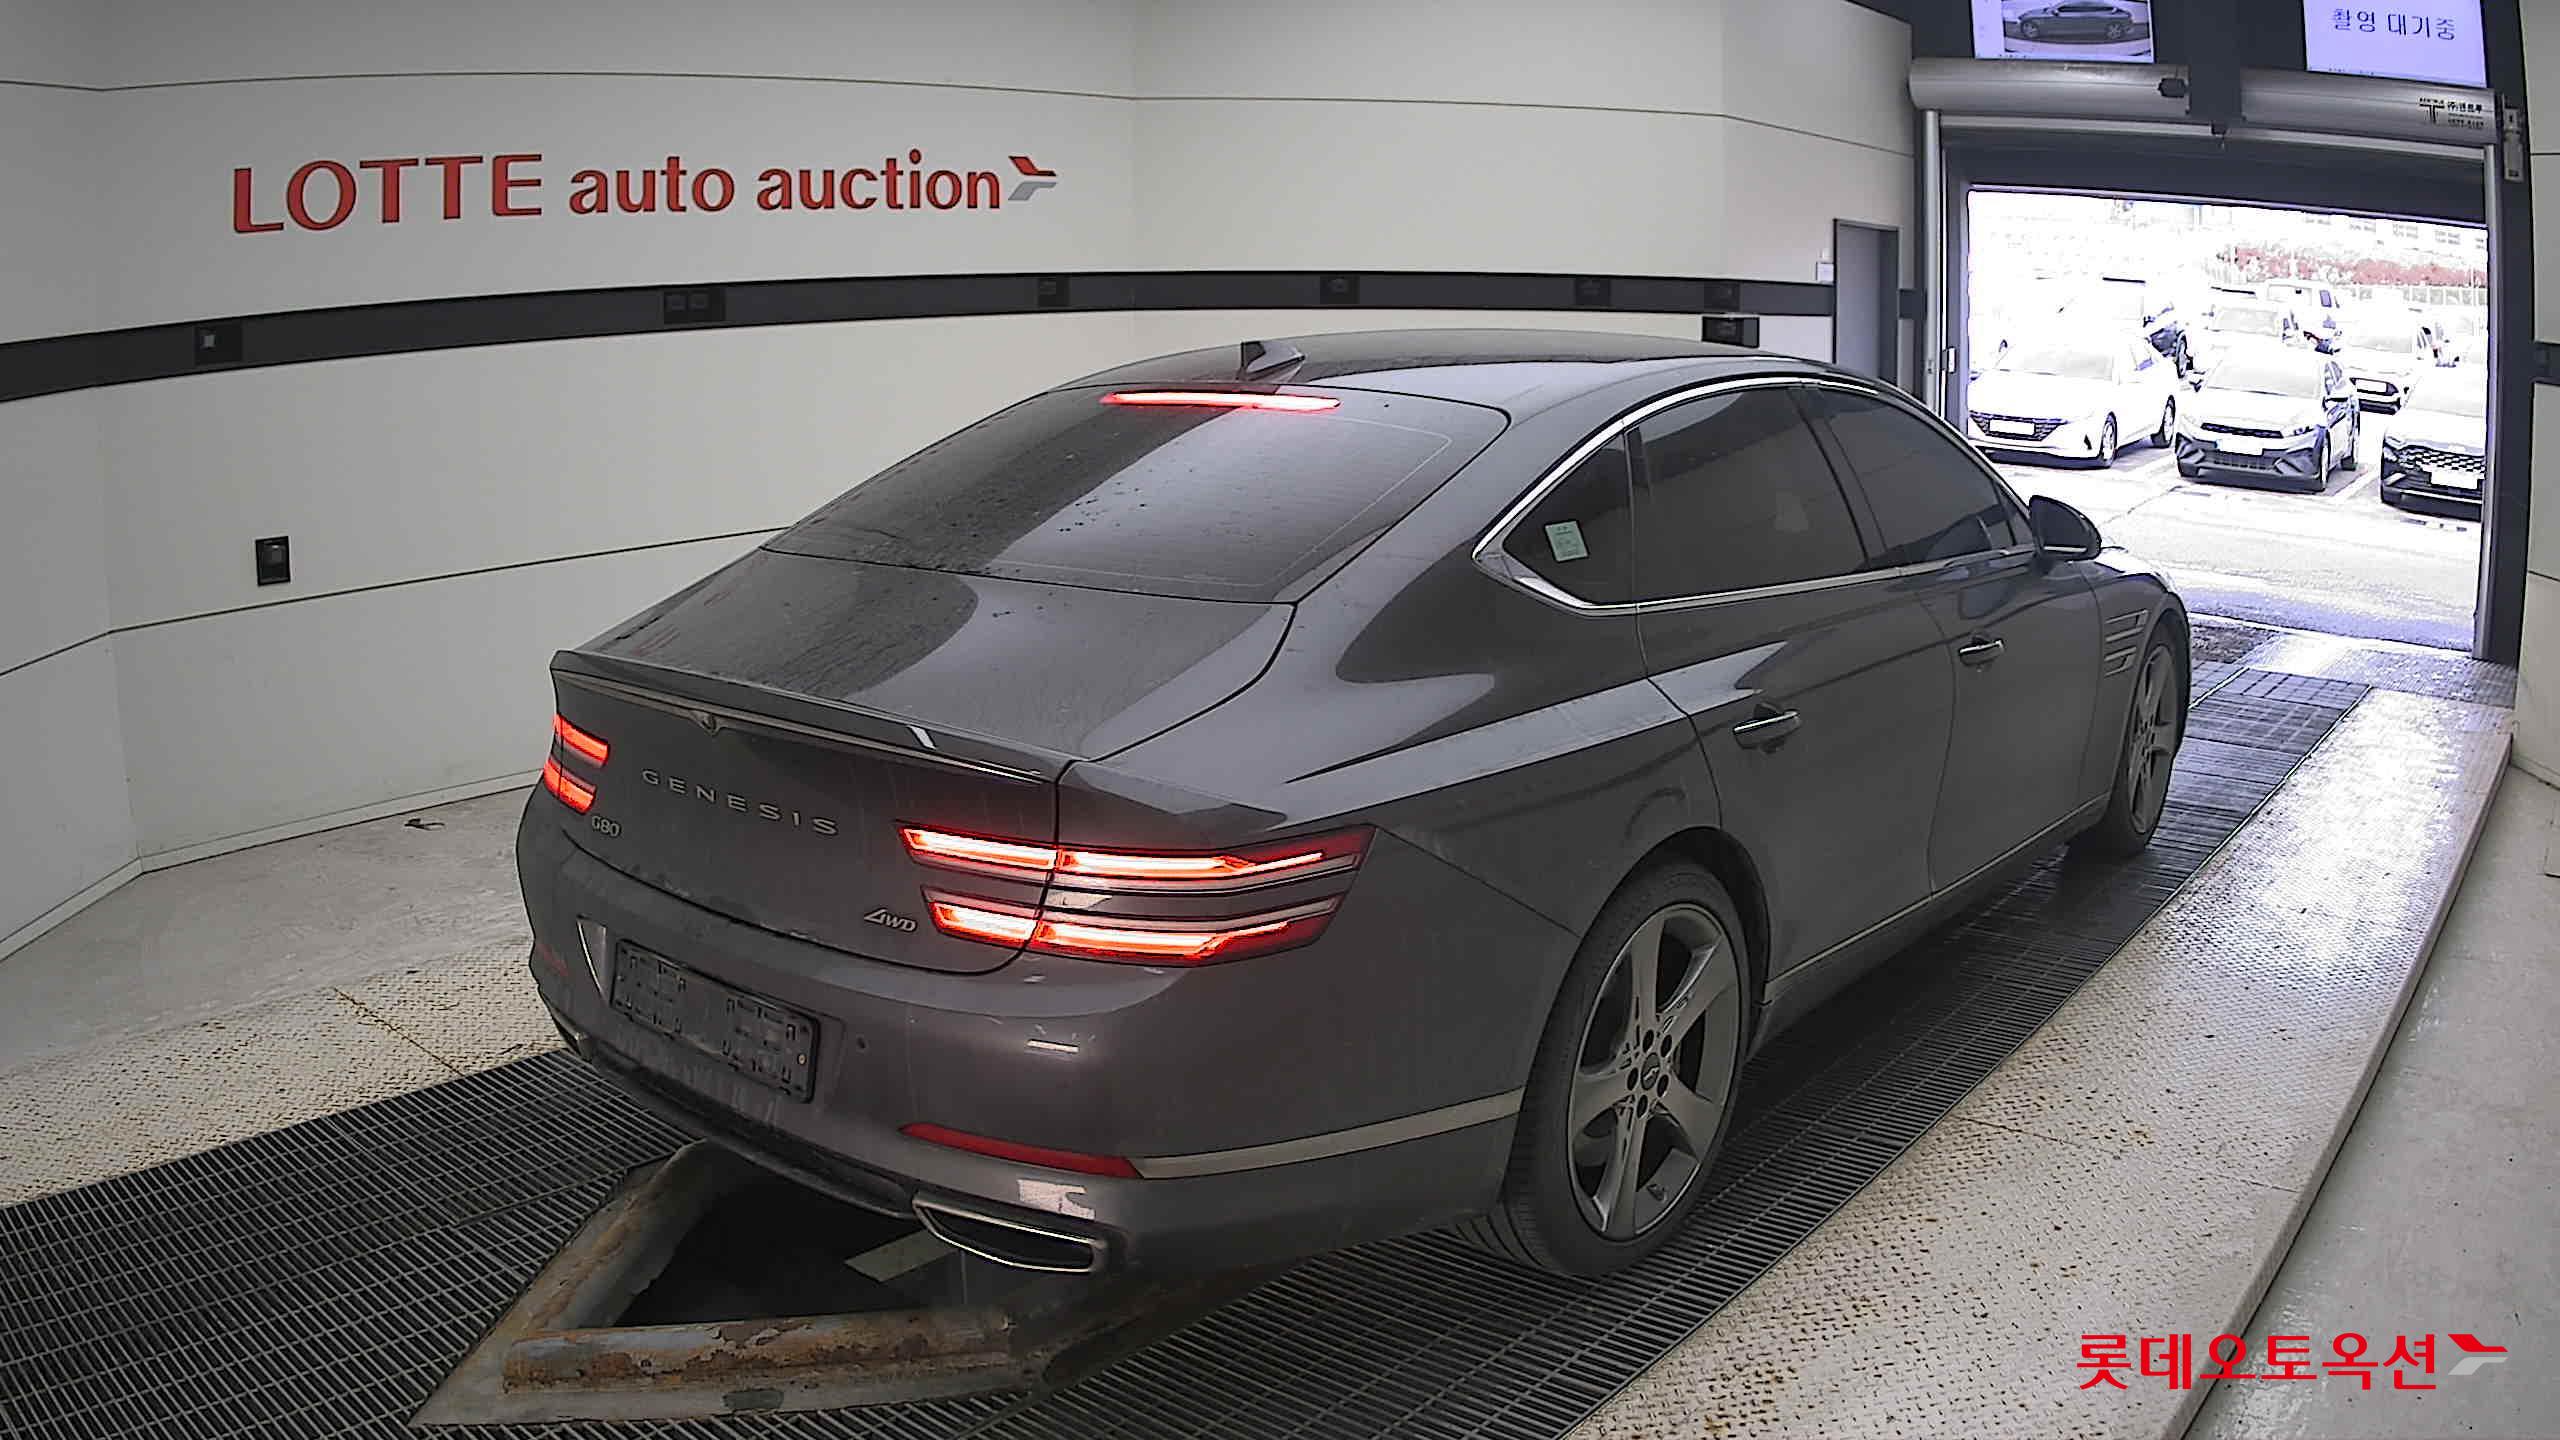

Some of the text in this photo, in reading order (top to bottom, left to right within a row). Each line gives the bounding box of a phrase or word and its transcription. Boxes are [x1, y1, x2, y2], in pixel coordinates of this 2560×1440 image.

[2333, 8, 2456, 41] 촬영 대기중
[233, 148, 1001, 234] LOTTE auto auction
[591, 815, 621, 837] G80
[641, 768, 839, 837] GENESIS
